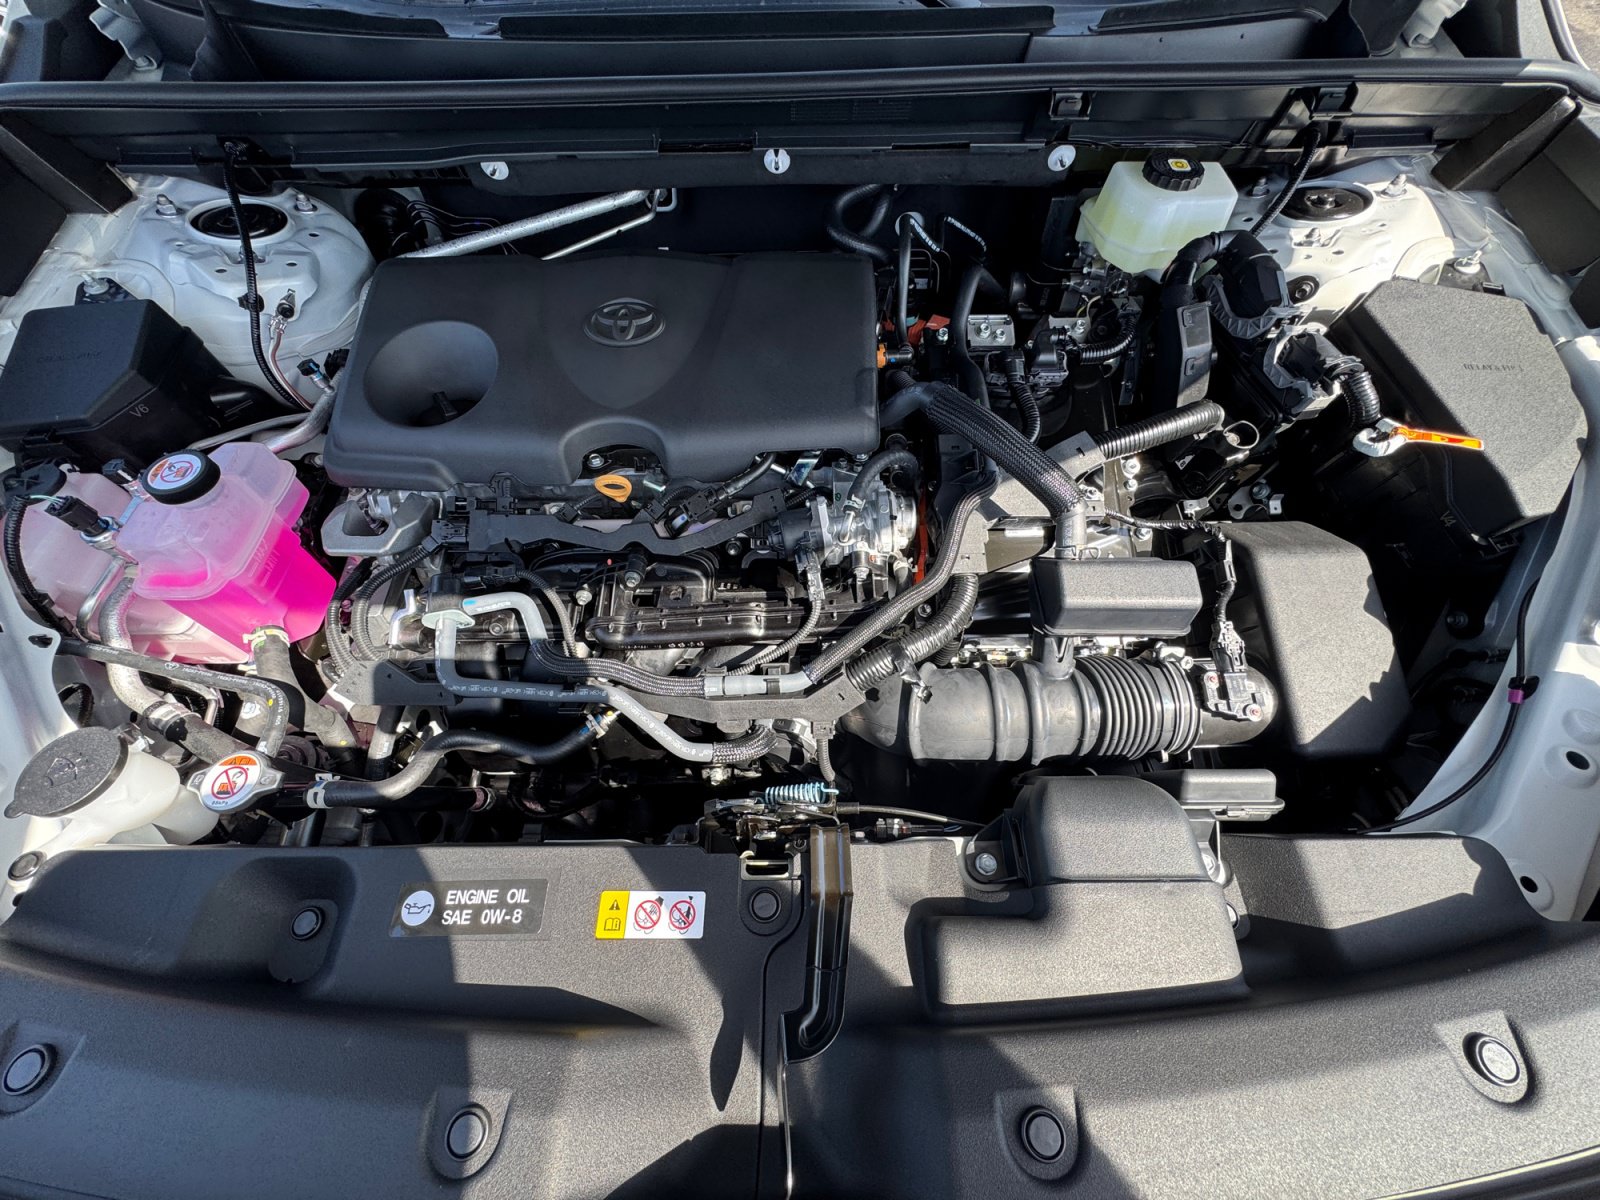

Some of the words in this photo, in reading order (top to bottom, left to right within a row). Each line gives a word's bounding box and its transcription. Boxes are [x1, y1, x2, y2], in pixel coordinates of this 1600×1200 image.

[129, 403, 149, 417] V6
[445, 889, 499, 905] ENGINE
[506, 888, 530, 904] OIL
[441, 909, 472, 925] SAE
[480, 908, 522, 925] 0W-8
